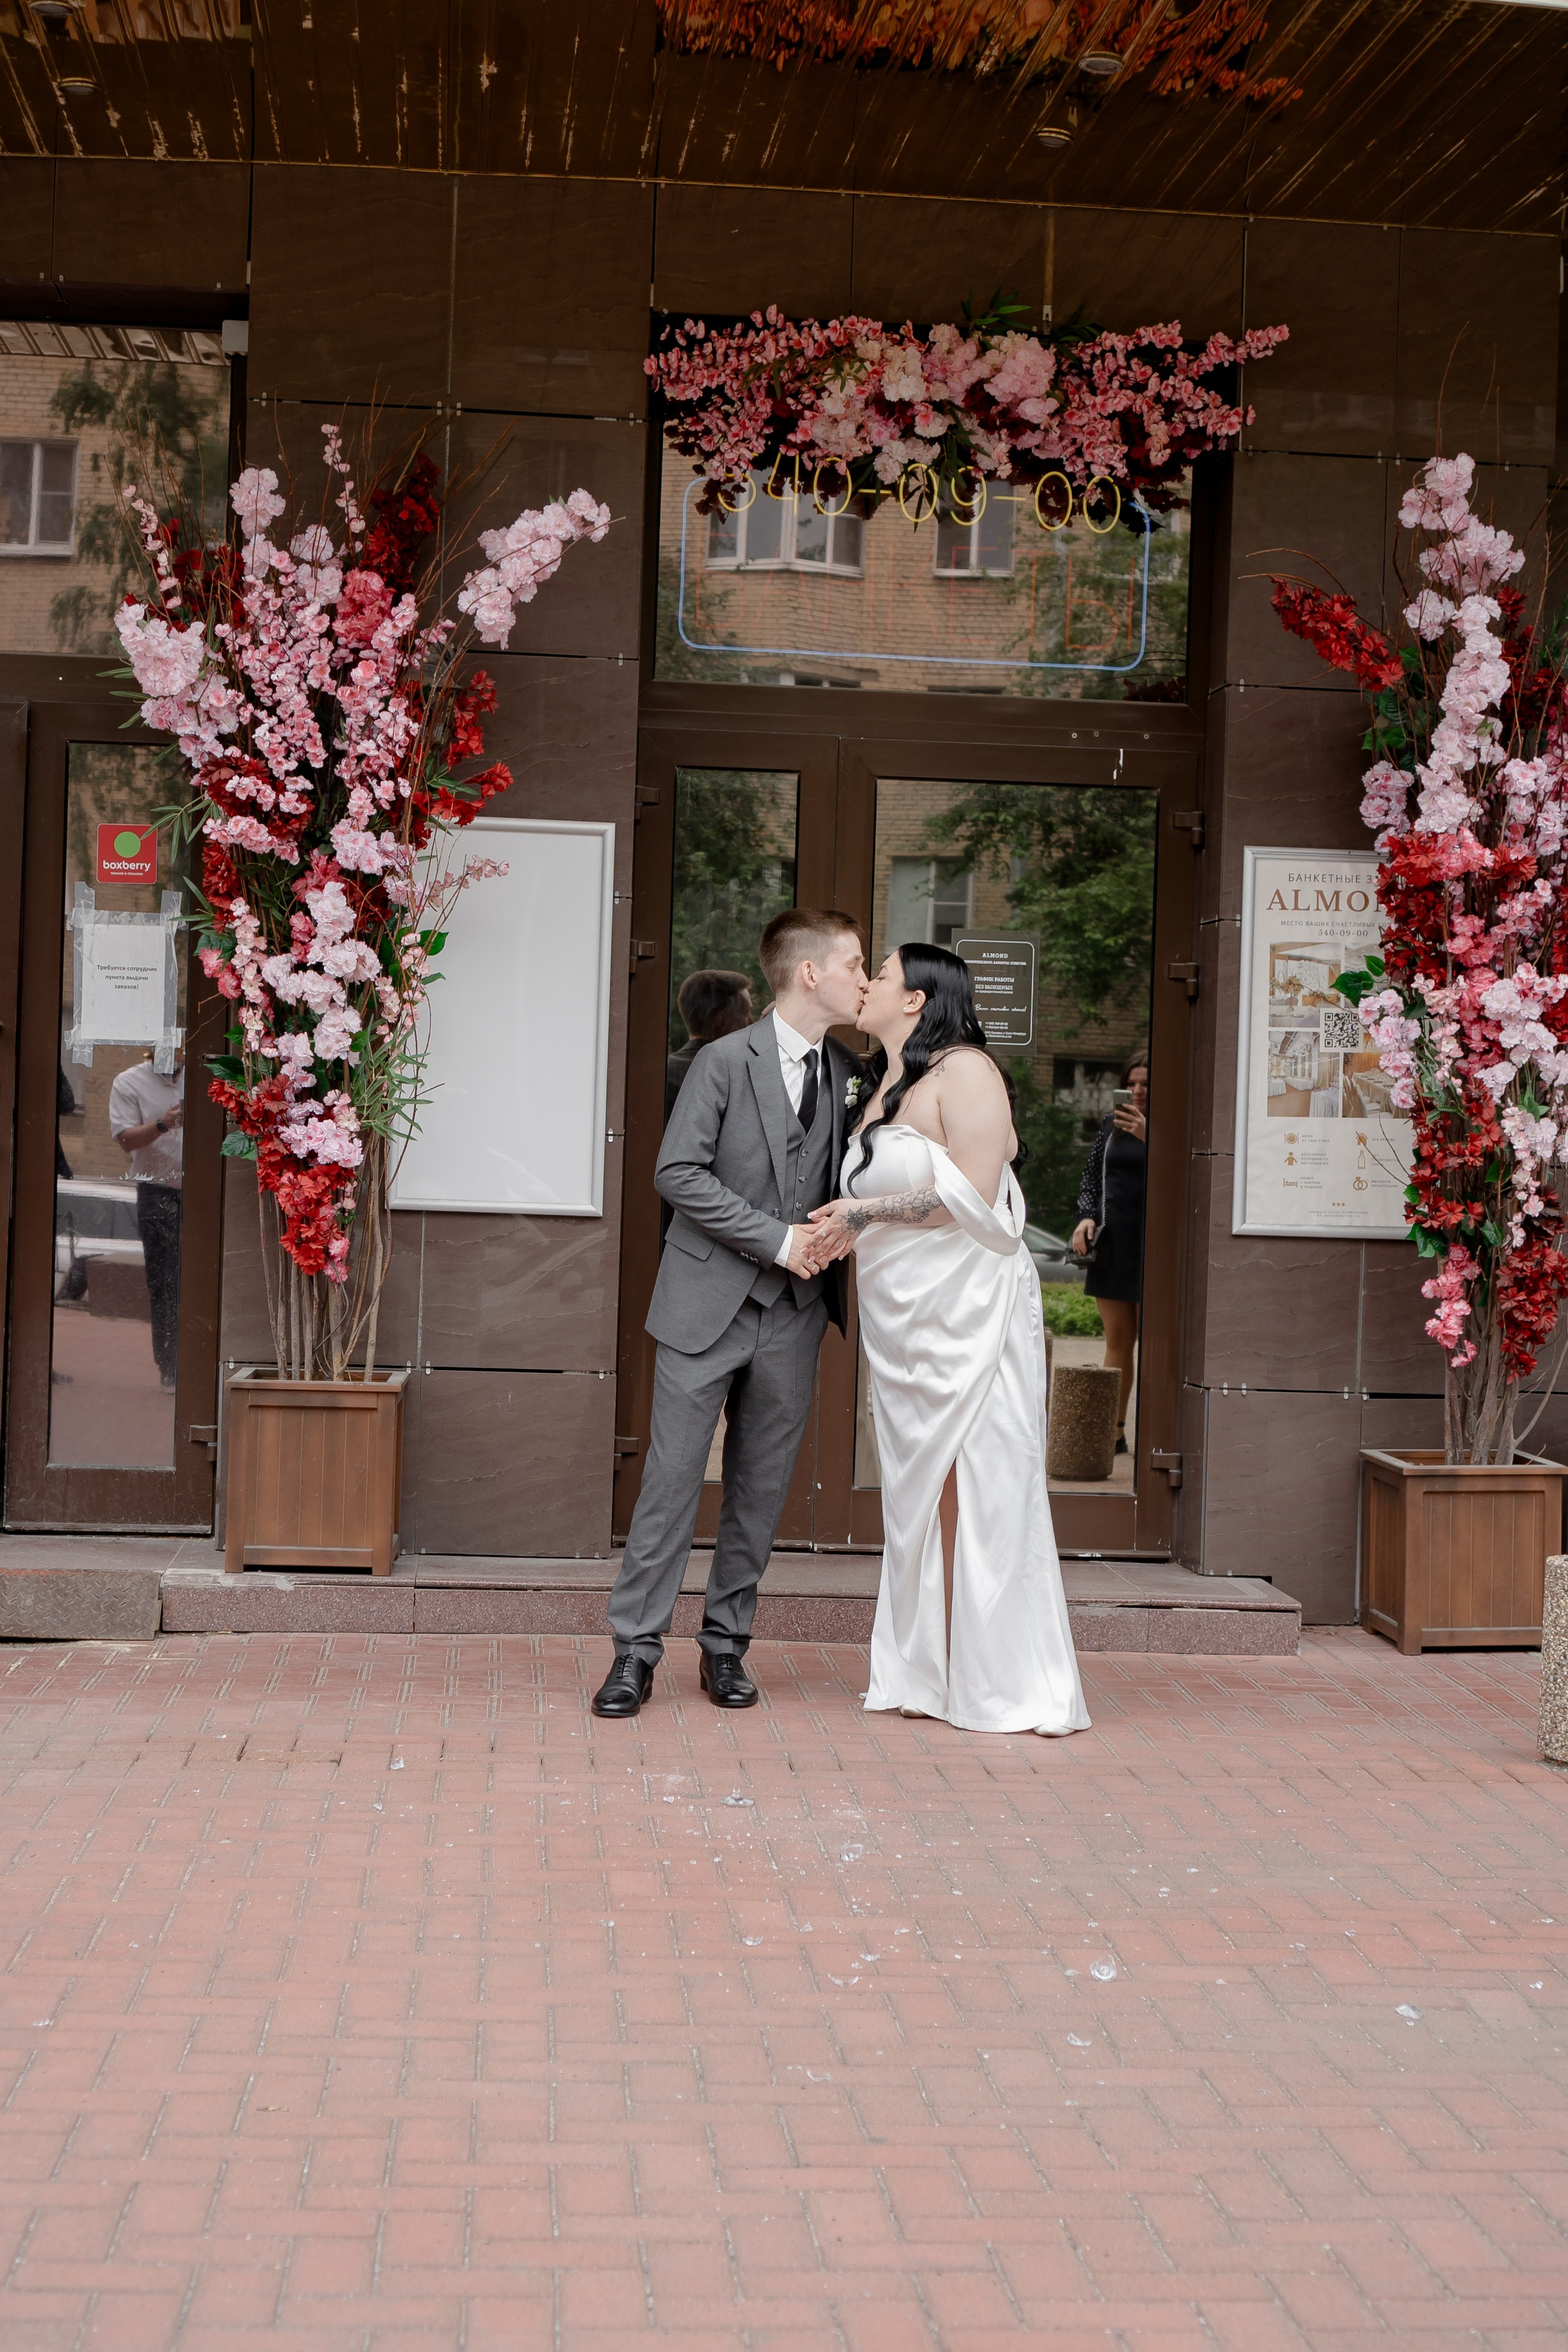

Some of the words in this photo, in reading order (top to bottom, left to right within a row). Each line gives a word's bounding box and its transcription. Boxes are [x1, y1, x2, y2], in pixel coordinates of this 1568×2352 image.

[103, 859, 151, 872] boxberry
[1288, 873, 1361, 883] БАНКЕТНЫЕ
[1317, 929, 1368, 937] 540-09-00
